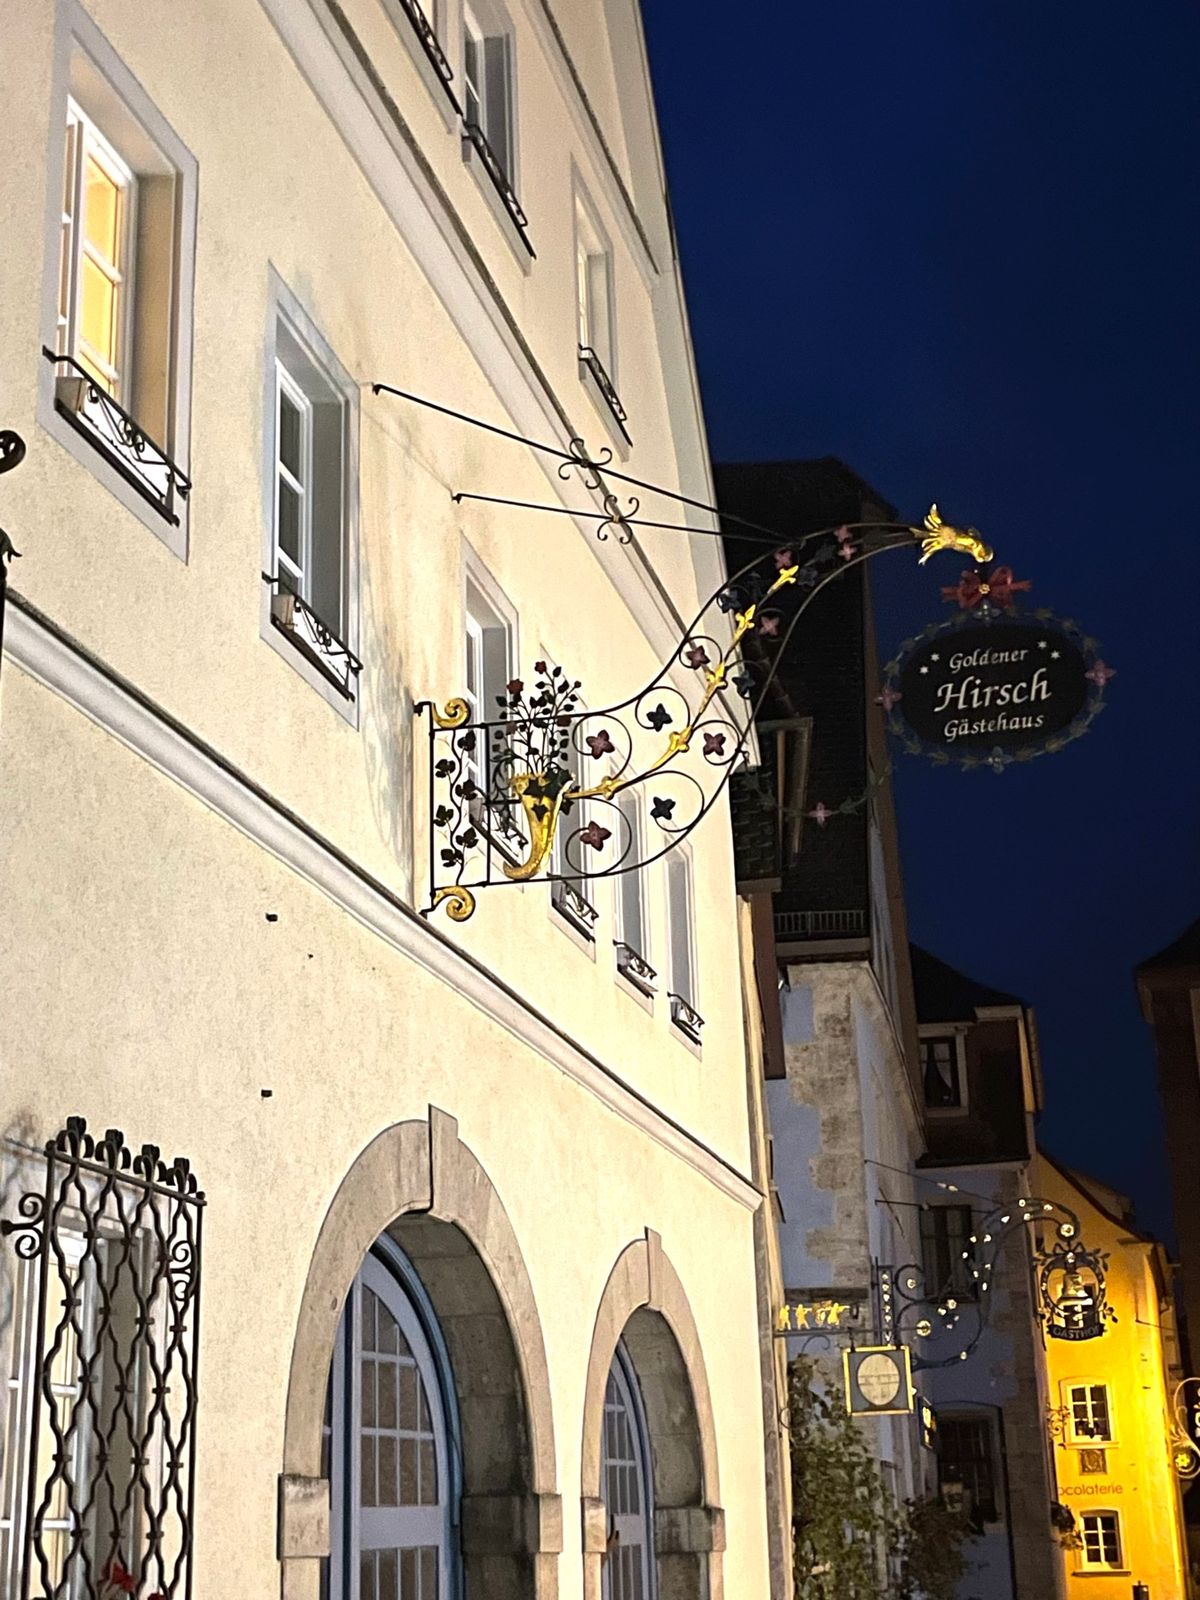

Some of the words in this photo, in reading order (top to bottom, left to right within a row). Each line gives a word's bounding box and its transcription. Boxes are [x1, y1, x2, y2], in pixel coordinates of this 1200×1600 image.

[949, 648, 1028, 674] Goldener
[933, 667, 1052, 712] Hirsch
[943, 712, 1044, 742] Gästehaus
